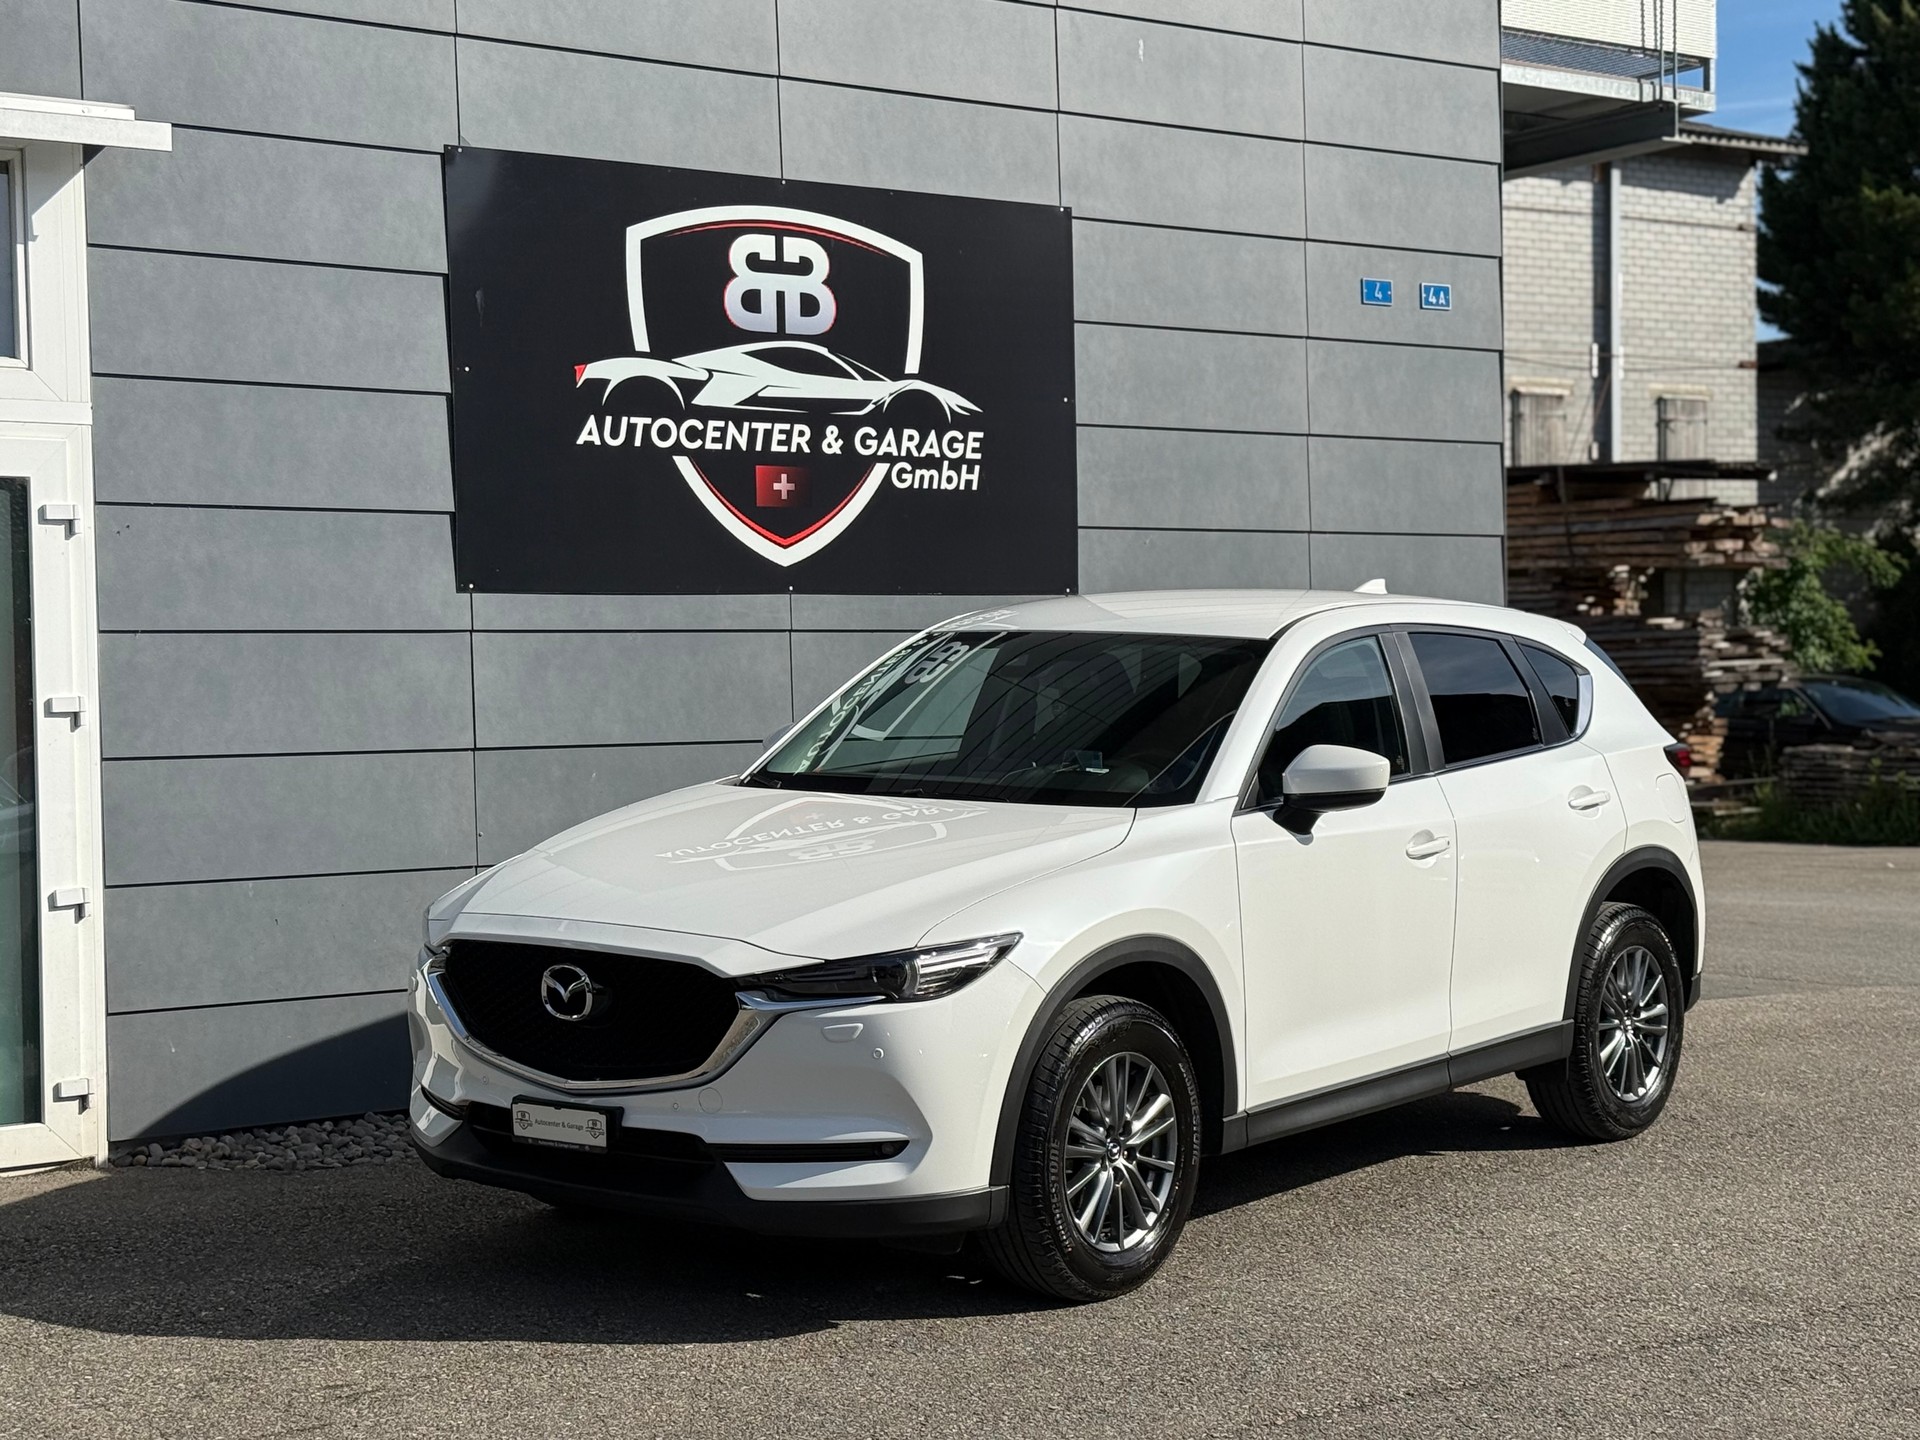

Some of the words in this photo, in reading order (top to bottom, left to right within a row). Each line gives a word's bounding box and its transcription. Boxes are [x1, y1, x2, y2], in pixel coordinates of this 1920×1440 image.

[1374, 282, 1383, 300] 4
[1428, 287, 1447, 305] 4A
[576, 414, 811, 453] AUTOCENTER
[821, 426, 844, 455] &
[854, 427, 985, 460] GARAGE
[890, 461, 981, 492] GmbH
[534, 1118, 561, 1128] Autocenter
[566, 1122, 584, 1131] Garage
